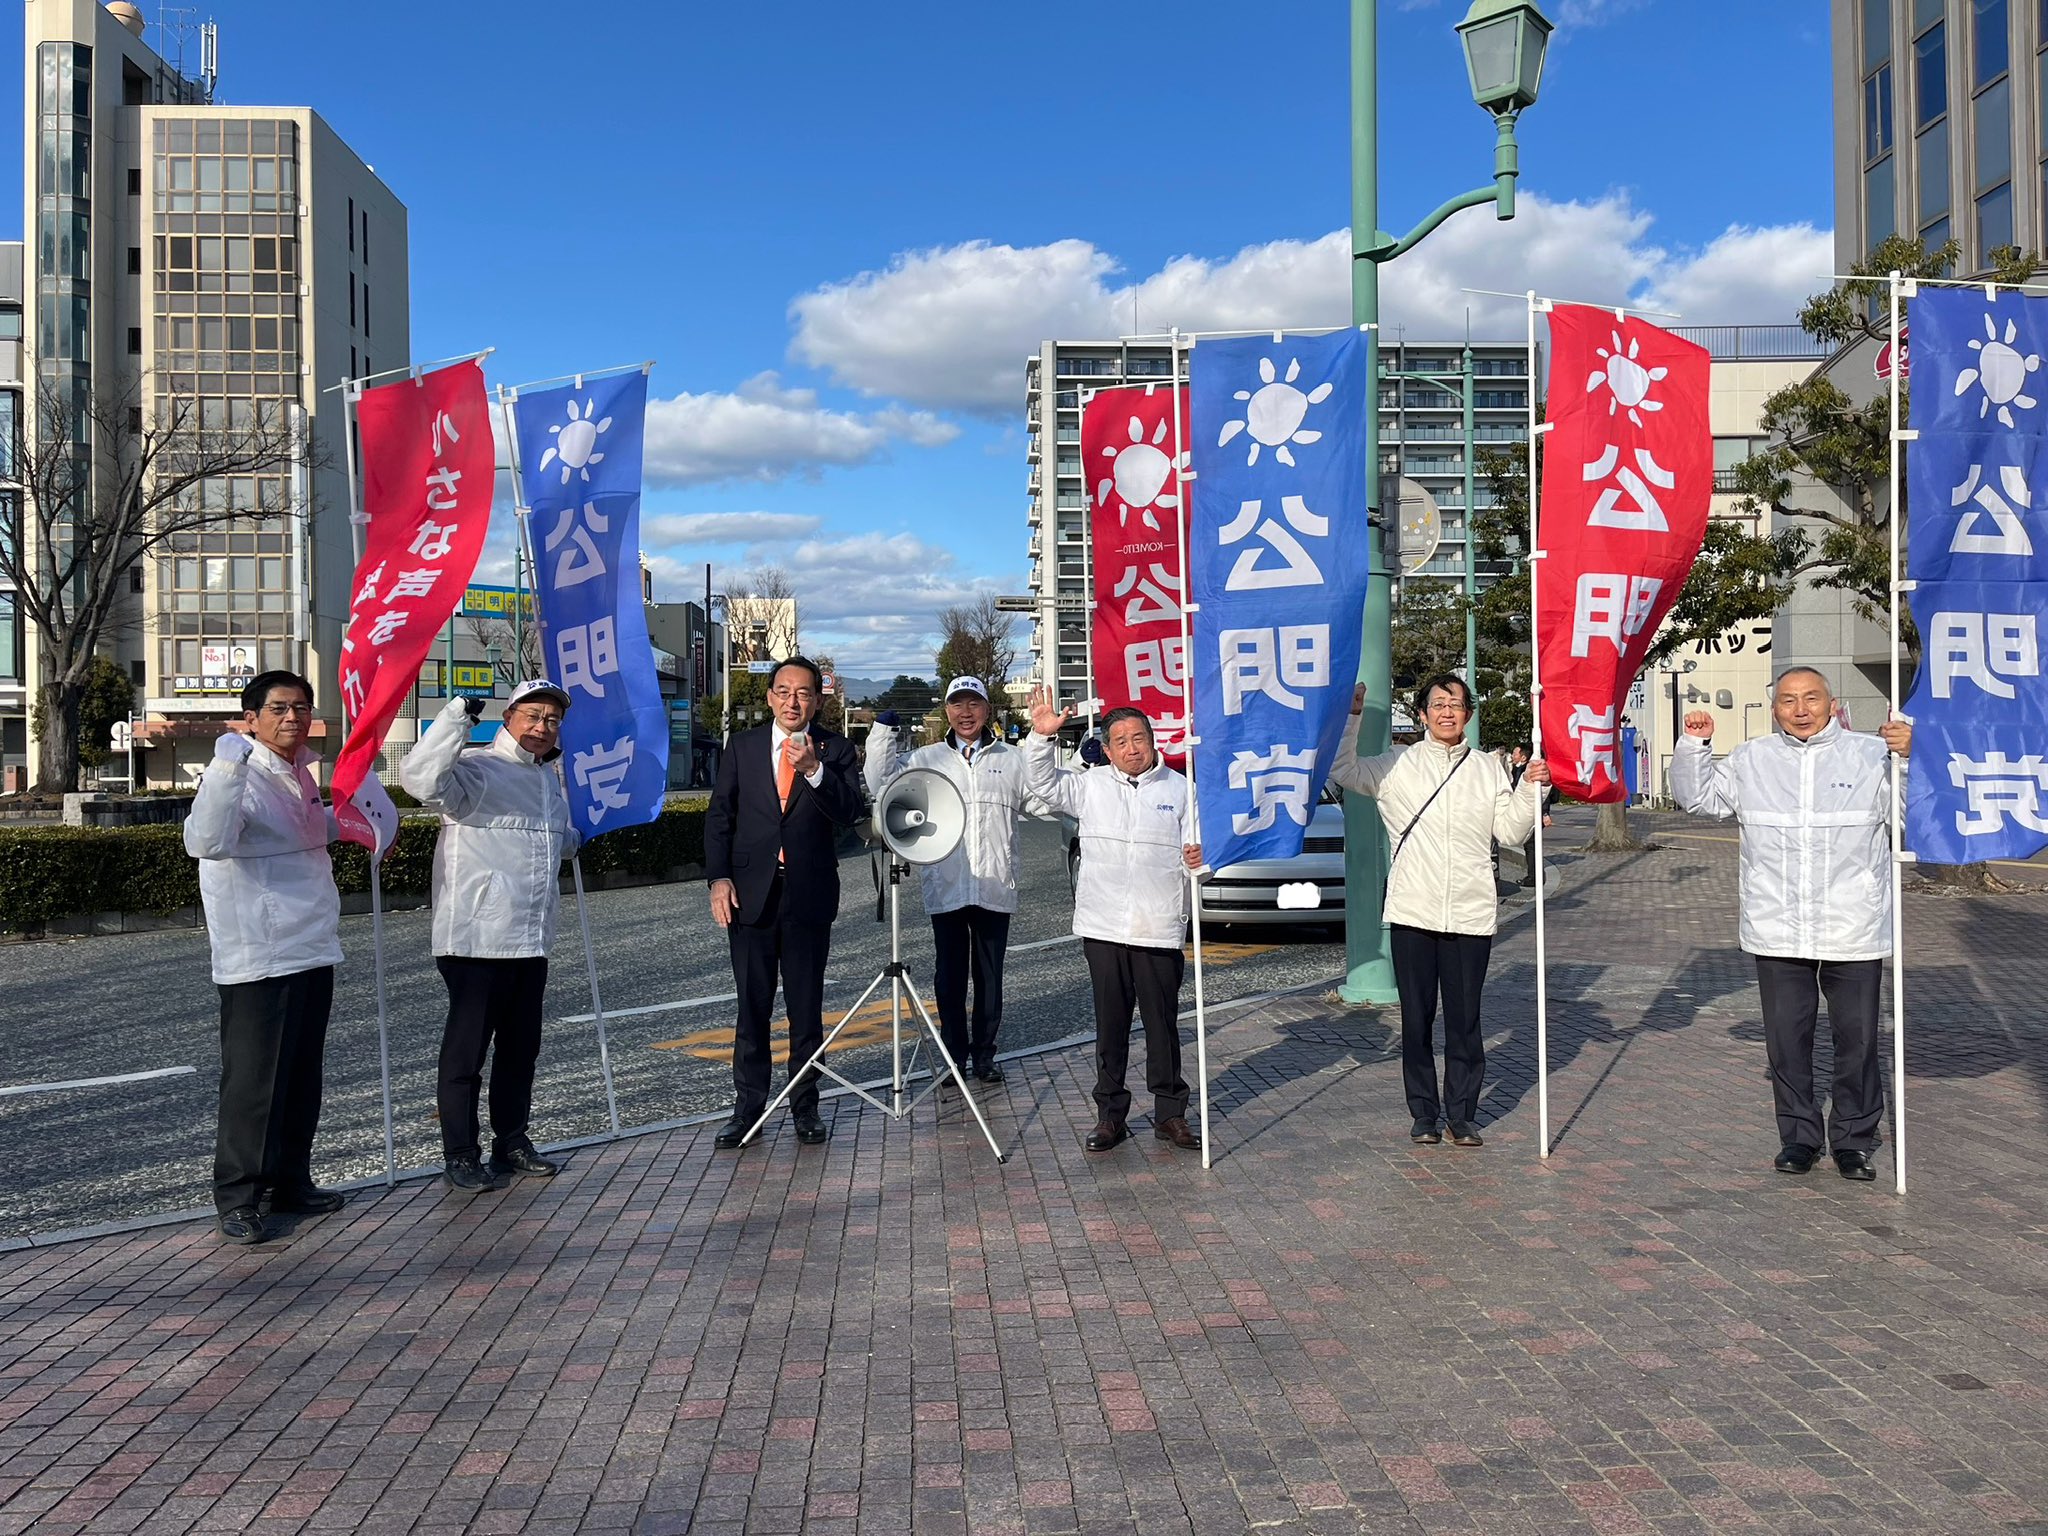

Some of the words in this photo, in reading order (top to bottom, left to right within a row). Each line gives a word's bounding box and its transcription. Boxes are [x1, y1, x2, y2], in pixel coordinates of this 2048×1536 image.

[367, 409, 461, 665] 小さな声を、
[204, 653, 226, 662] No.1
